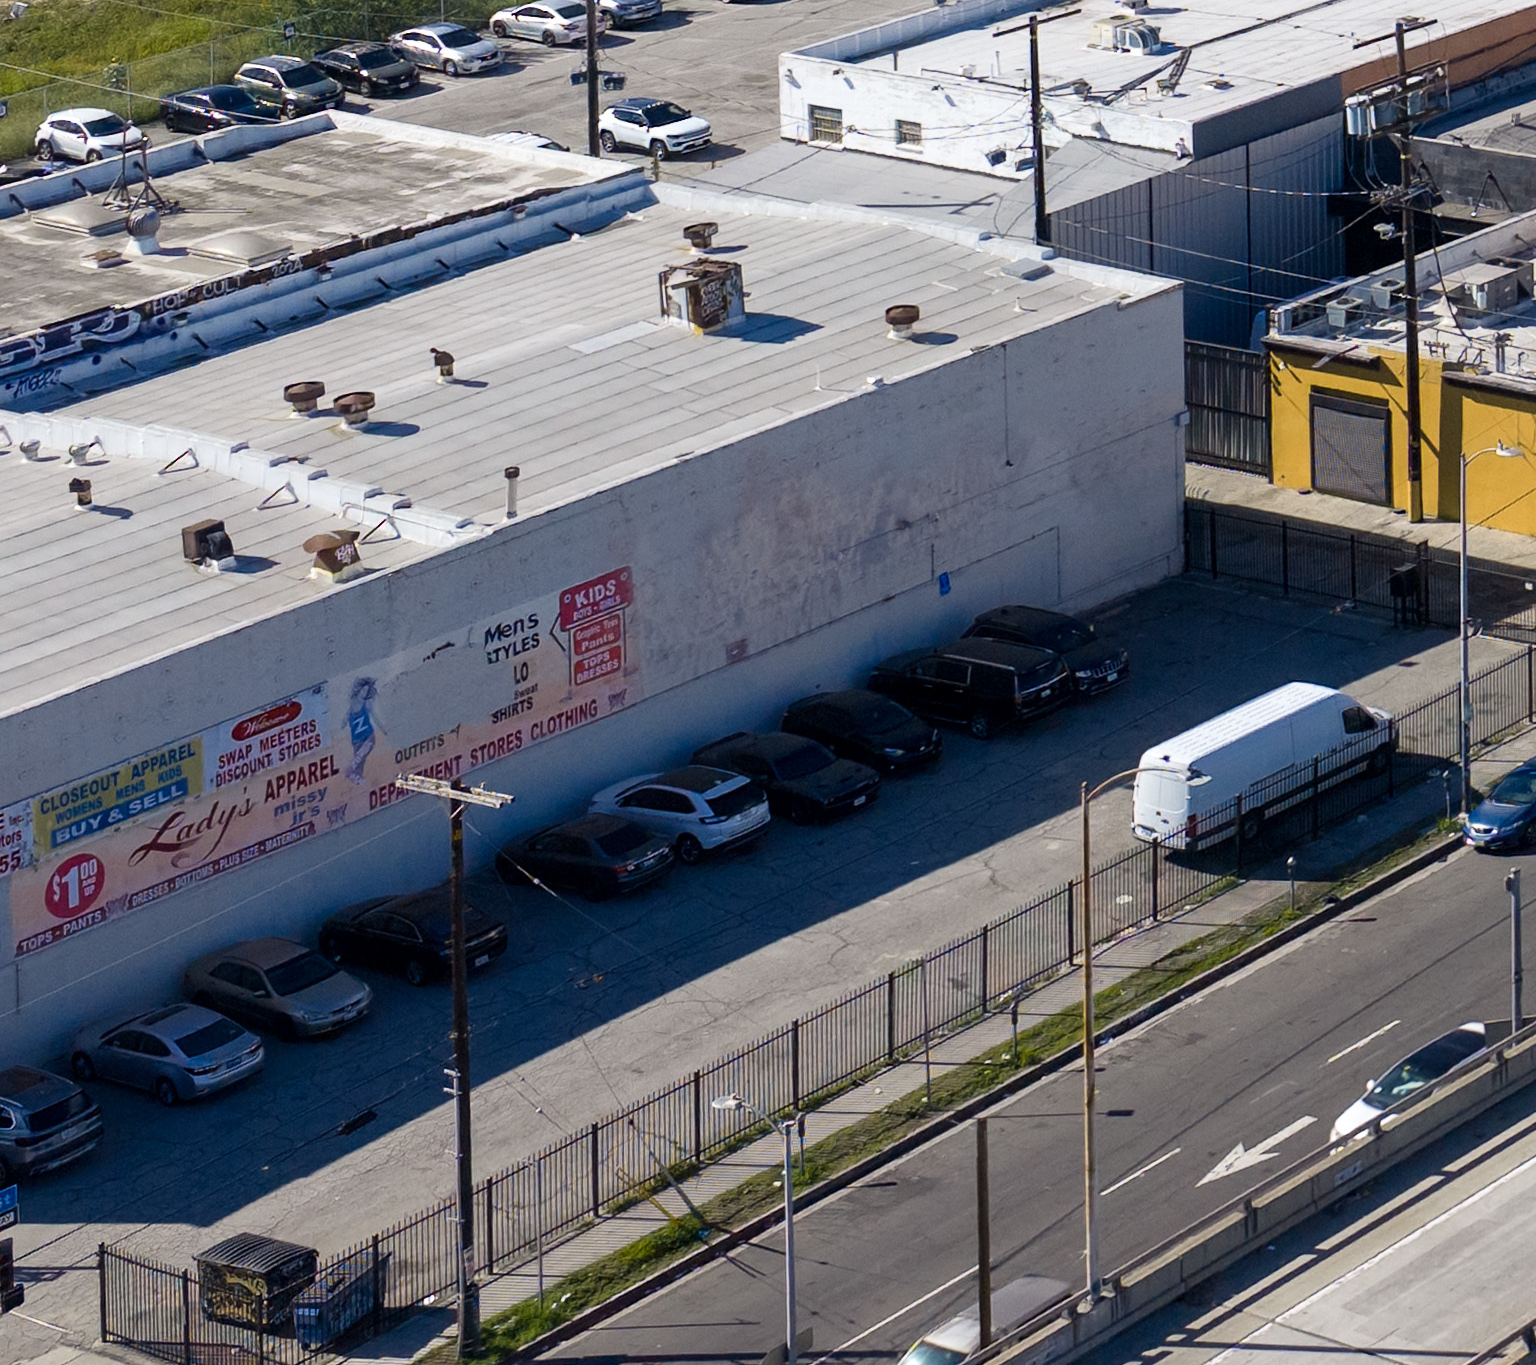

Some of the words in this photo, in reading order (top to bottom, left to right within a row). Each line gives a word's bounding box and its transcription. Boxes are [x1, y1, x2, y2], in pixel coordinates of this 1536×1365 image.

[575, 579, 616, 608] KIDS
[581, 632, 615, 651] Pants
[583, 650, 610, 667] TOPS
[576, 658, 619, 683] DRESSES
[491, 697, 534, 724] SHIRTS
[218, 744, 253, 770] SWAP
[260, 719, 317, 752] MEETERS
[395, 733, 445, 764] OUTFITS
[470, 731, 523, 767] STORES
[530, 699, 598, 741] CLOTHING
[40, 771, 121, 815] CLOSEOUT
[131, 742, 196, 781] APPAREL
[216, 753, 272, 788] DISCOUNT
[279, 733, 322, 762] STORES
[264, 755, 341, 803] APPAREL
[55, 797, 103, 824] WOMENS
[116, 779, 146, 800] MENS
[158, 765, 183, 784] KIDS
[56, 817, 103, 844] BUY
[108, 806, 124, 820] &
[129, 784, 184, 812] SELL
[273, 787, 328, 818] missy
[132, 882, 169, 907] DRESSES
[174, 863, 214, 889] BOTTOMS
[219, 851, 240, 870] PLUS
[241, 844, 260, 861] SIZE
[265, 826, 310, 853] MATERNITY
[84, 885, 96, 897] UP
[20, 930, 53, 953] TOPS
[63, 910, 102, 935] PANTS
